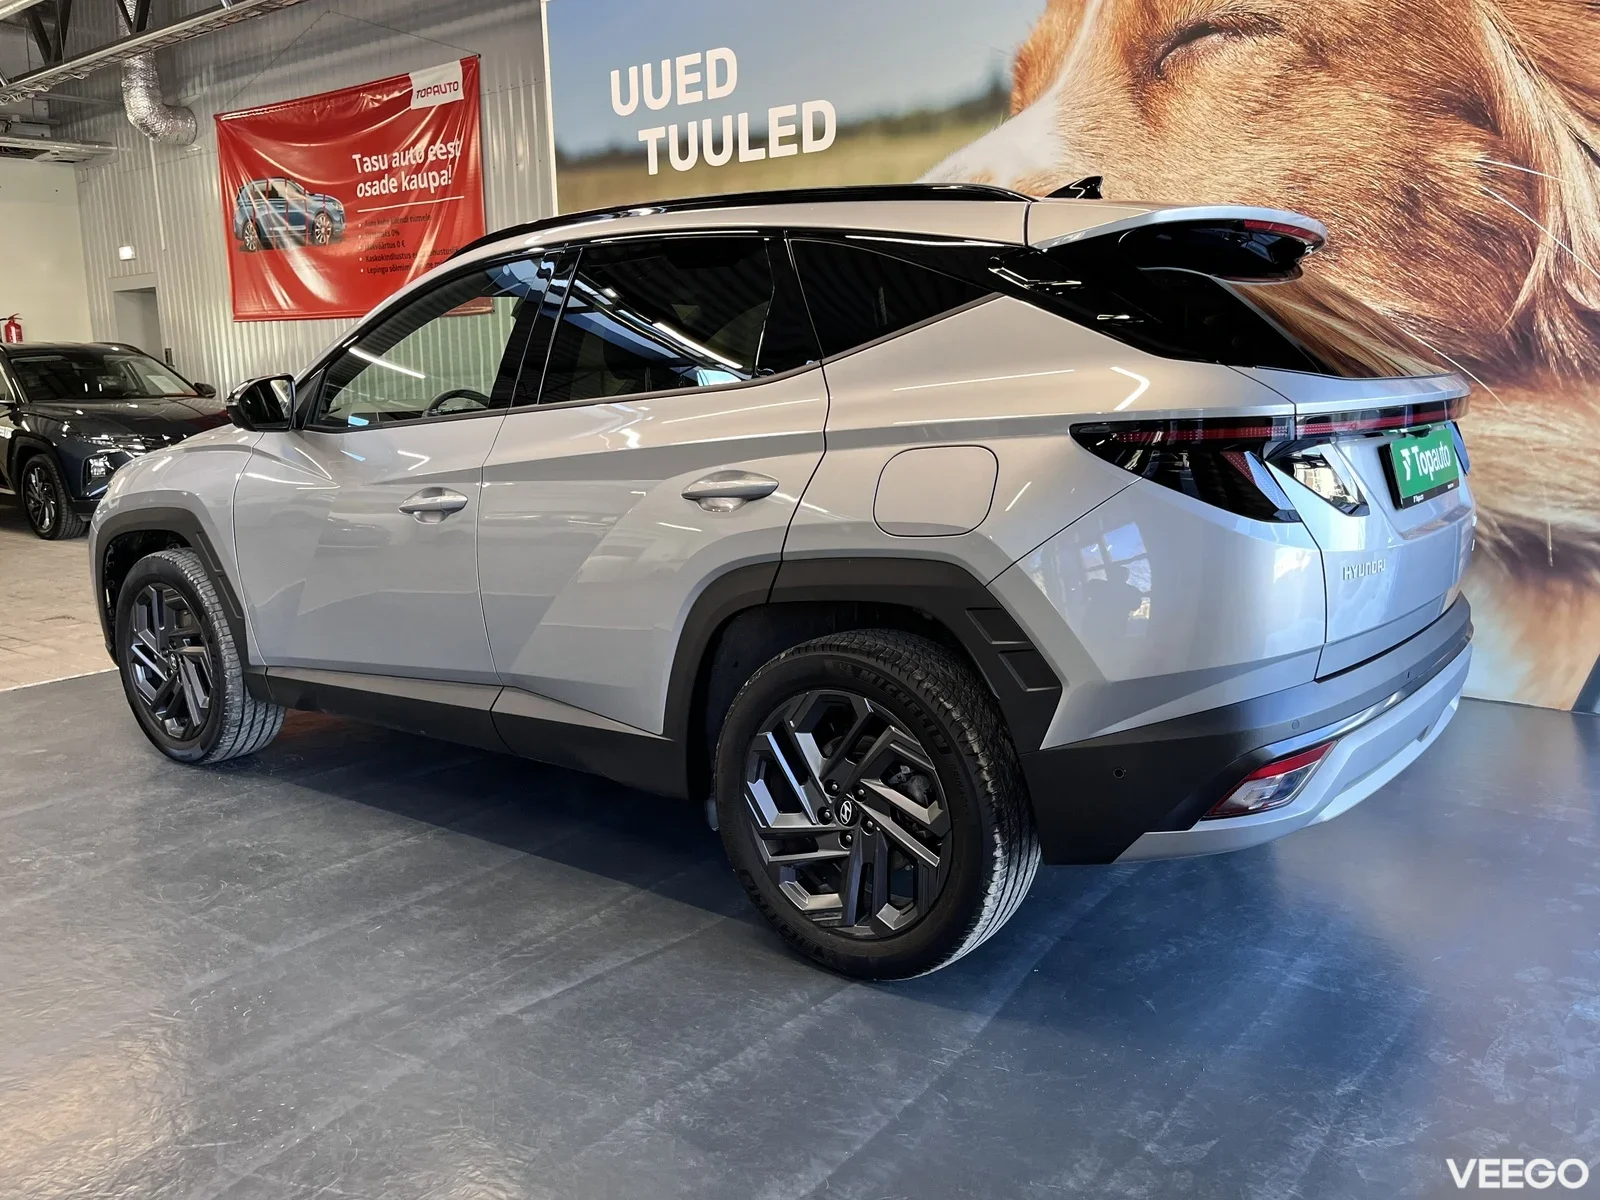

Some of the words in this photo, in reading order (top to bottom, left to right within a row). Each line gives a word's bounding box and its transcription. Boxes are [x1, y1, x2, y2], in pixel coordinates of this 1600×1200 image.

[416, 81, 459, 99] TOPAUTO
[610, 47, 738, 116] UUED
[638, 99, 837, 176] TUULED
[352, 153, 388, 174] Tasu
[392, 146, 425, 168] auto
[428, 138, 462, 162] eest
[356, 173, 398, 198] osade
[401, 164, 452, 194] kaupa!
[367, 265, 388, 274] Lepingu
[1411, 441, 1451, 481] Topauto
[1342, 559, 1386, 581] HYUNDAI
[859, 668, 950, 753] MICHELIN
